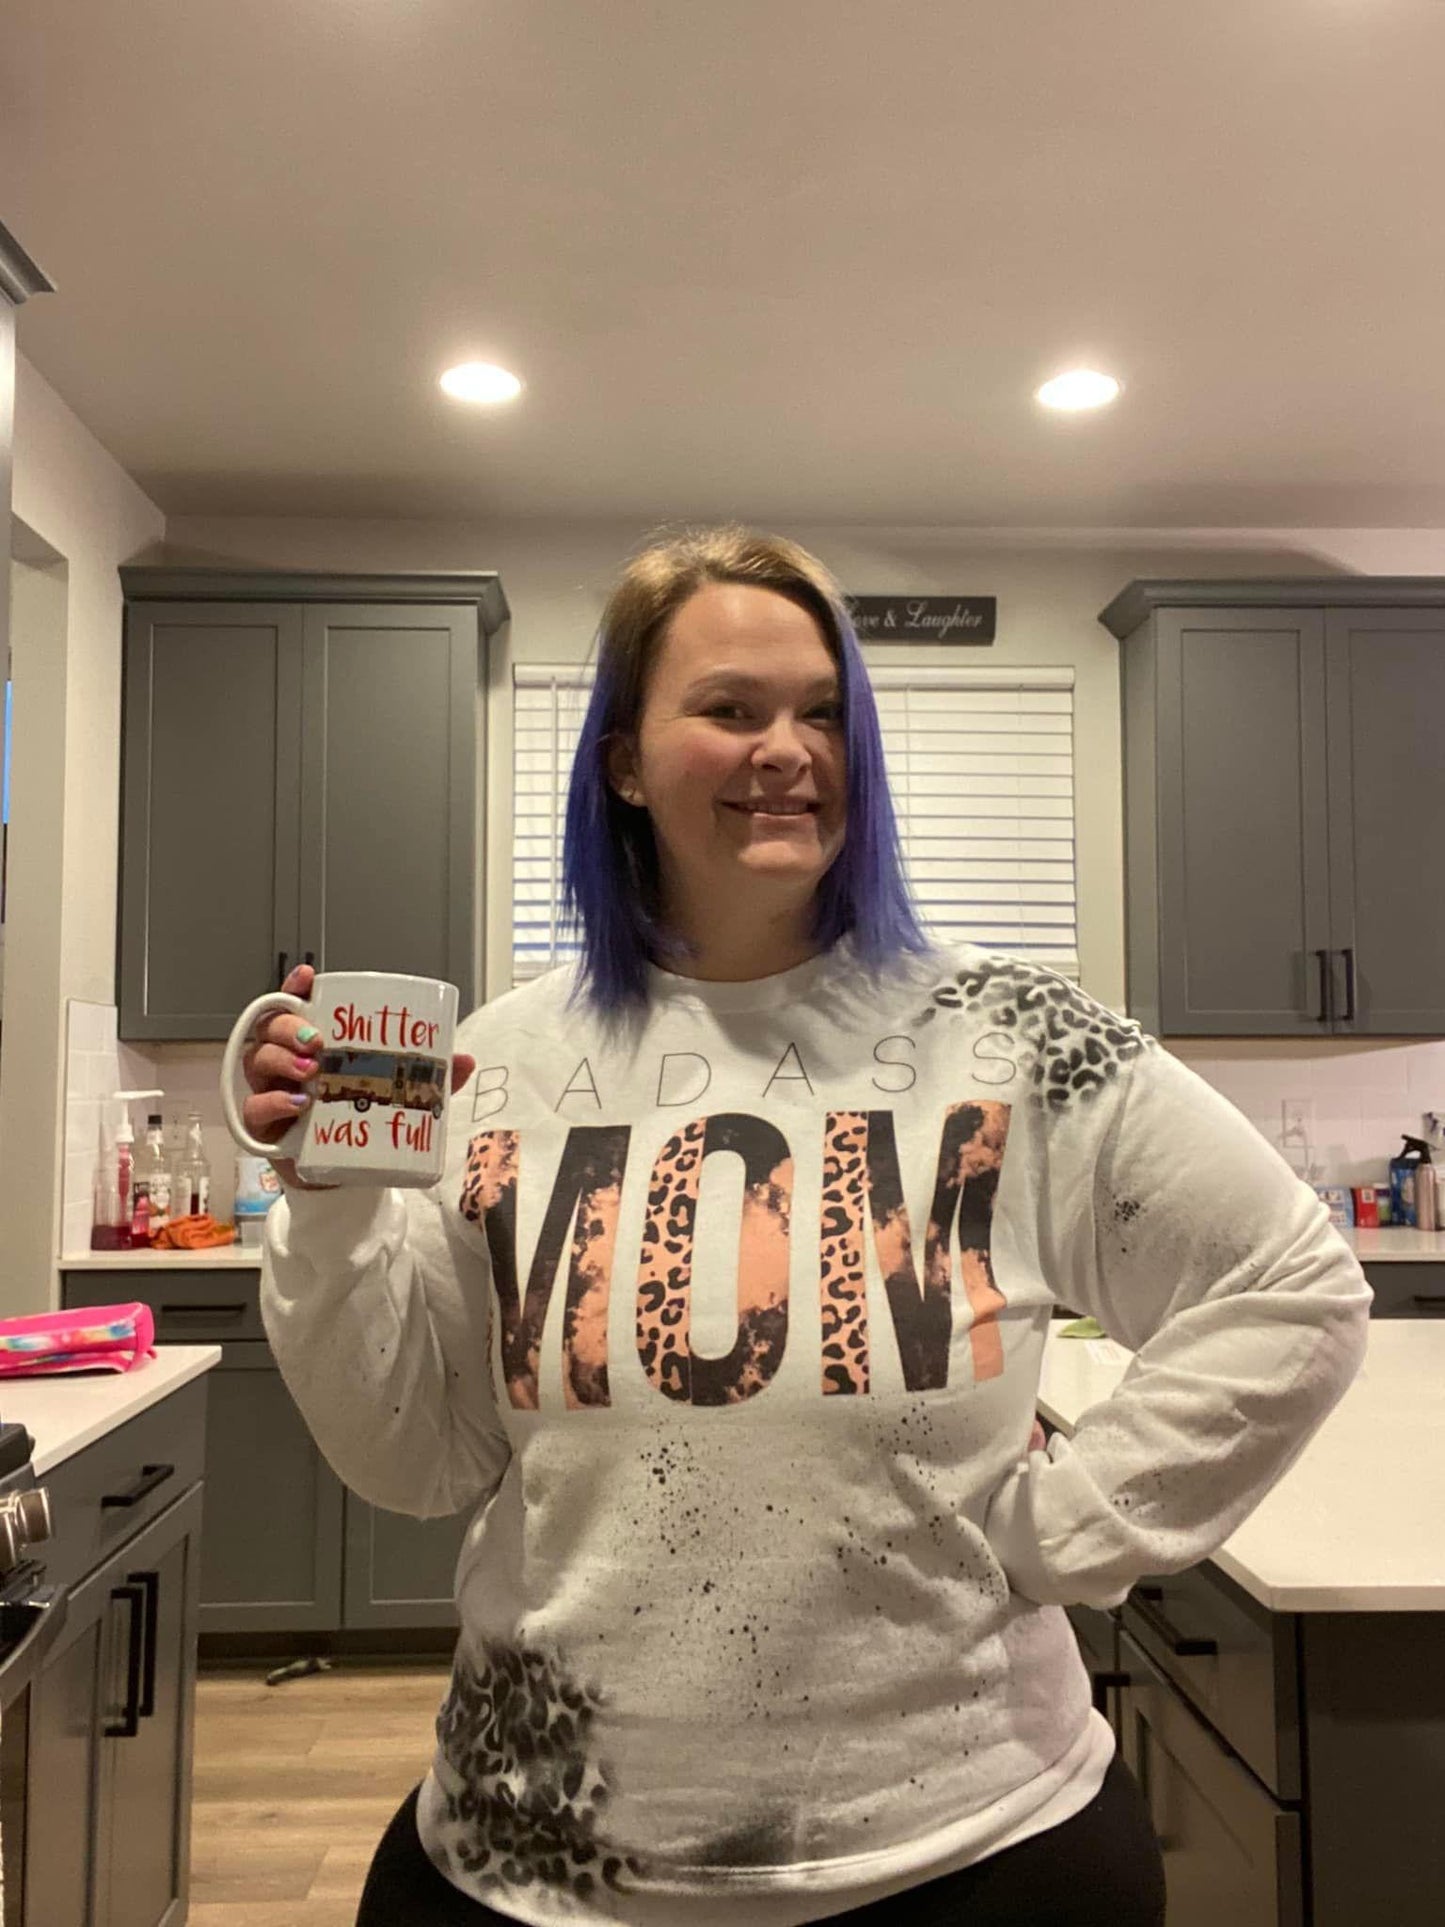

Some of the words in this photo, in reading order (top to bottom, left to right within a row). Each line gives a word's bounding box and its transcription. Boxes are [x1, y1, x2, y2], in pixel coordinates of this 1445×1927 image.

[884, 609, 896, 628] &
[904, 600, 983, 638] Laughter
[332, 1003, 440, 1048] Shitter
[471, 1032, 1017, 1122] BADASS
[314, 1119, 371, 1148] was
[385, 1111, 433, 1152] full
[460, 1100, 1013, 1410] MOM
